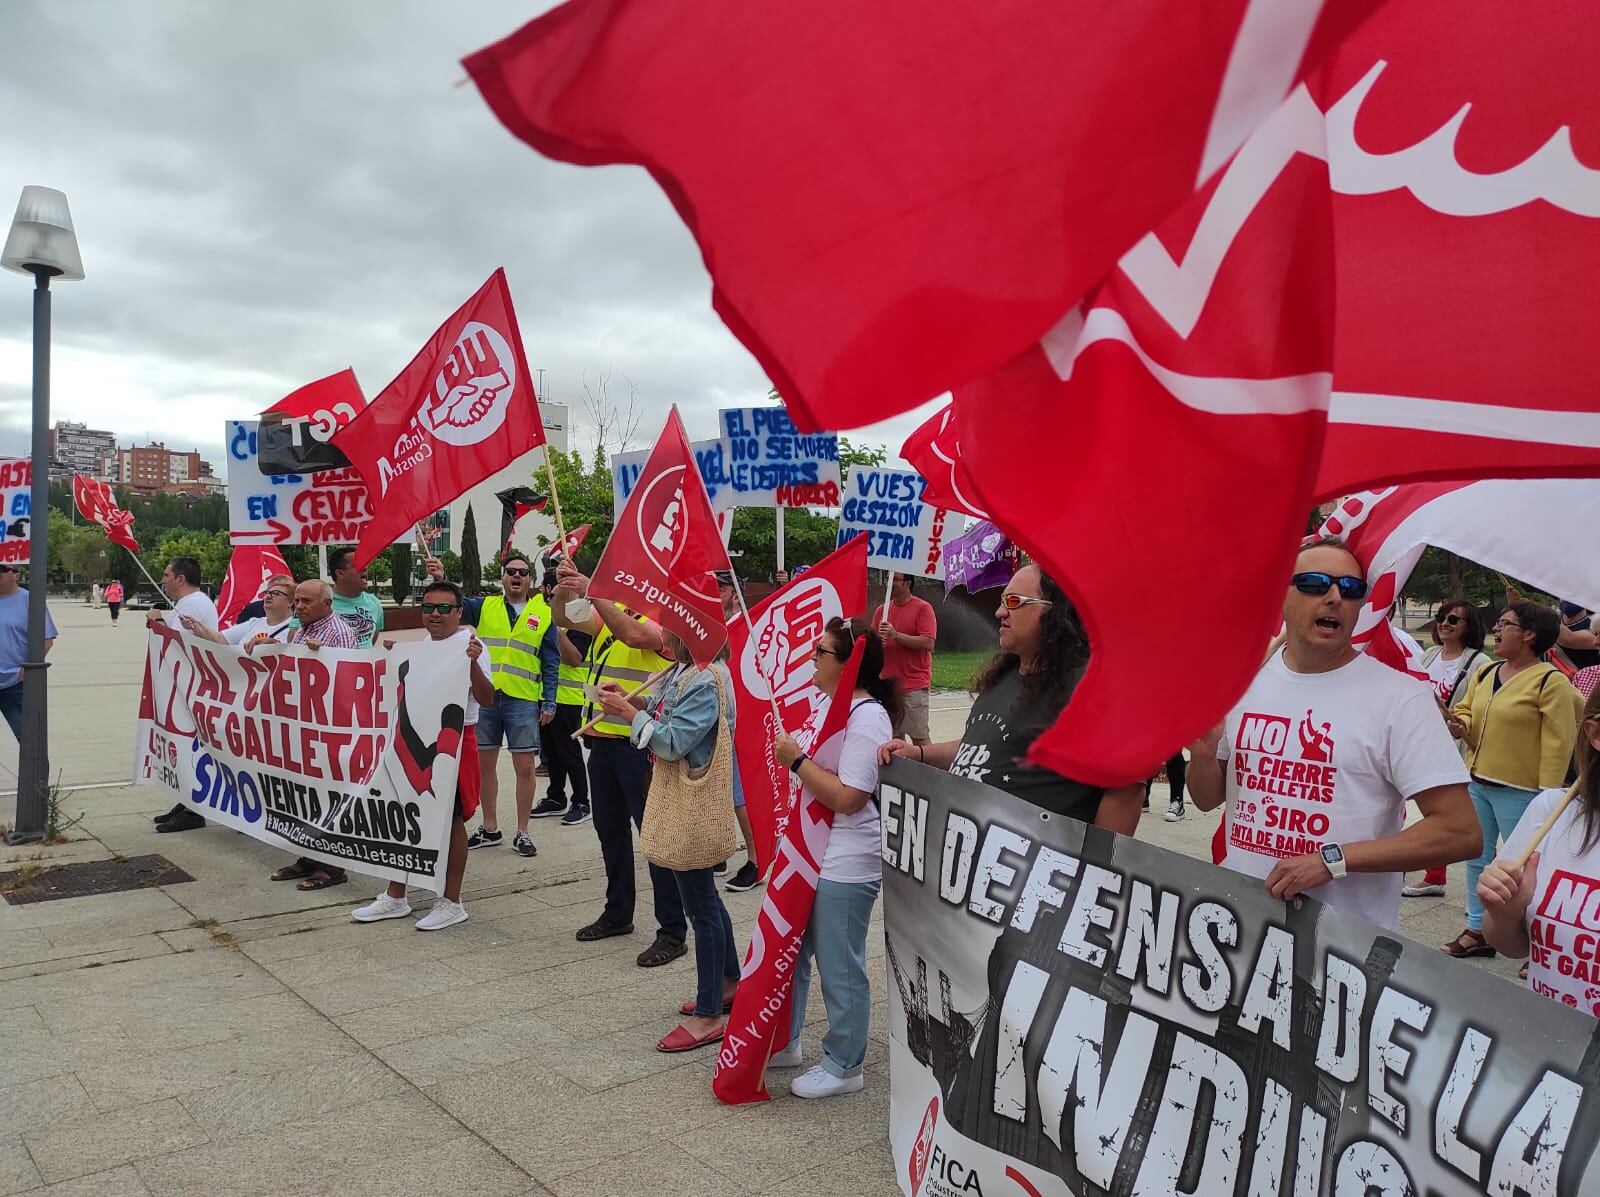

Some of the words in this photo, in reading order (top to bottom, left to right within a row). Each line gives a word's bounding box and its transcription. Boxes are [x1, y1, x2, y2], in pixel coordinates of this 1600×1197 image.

[725, 409, 751, 438] EL
[731, 437, 759, 461] NO
[765, 436, 792, 460] SE
[730, 463, 749, 492] LE
[776, 479, 840, 507] MORIR
[247, 495, 277, 521] EN
[191, 645, 236, 705] AL
[238, 653, 388, 729] CIERRE
[192, 701, 223, 751] DE
[1240, 717, 1287, 753] NO
[1235, 752, 1251, 773] AL
[1258, 756, 1337, 788] CIERRE
[191, 753, 262, 823] SIRO
[257, 772, 322, 825] VENTA
[339, 787, 422, 846] BAÑOS
[1247, 776, 1334, 804] GALLETAS
[1265, 805, 1330, 836] SIRO
[1256, 829, 1273, 847] DE
[1531, 918, 1563, 952] AL
[1532, 947, 1551, 970] DE
[880, 785, 928, 882] EN
[940, 812, 1294, 1052] DEFENSA
[1315, 953, 1434, 1134] DE
[1435, 1027, 1584, 1197] LA
[931, 1144, 983, 1197] FICA
